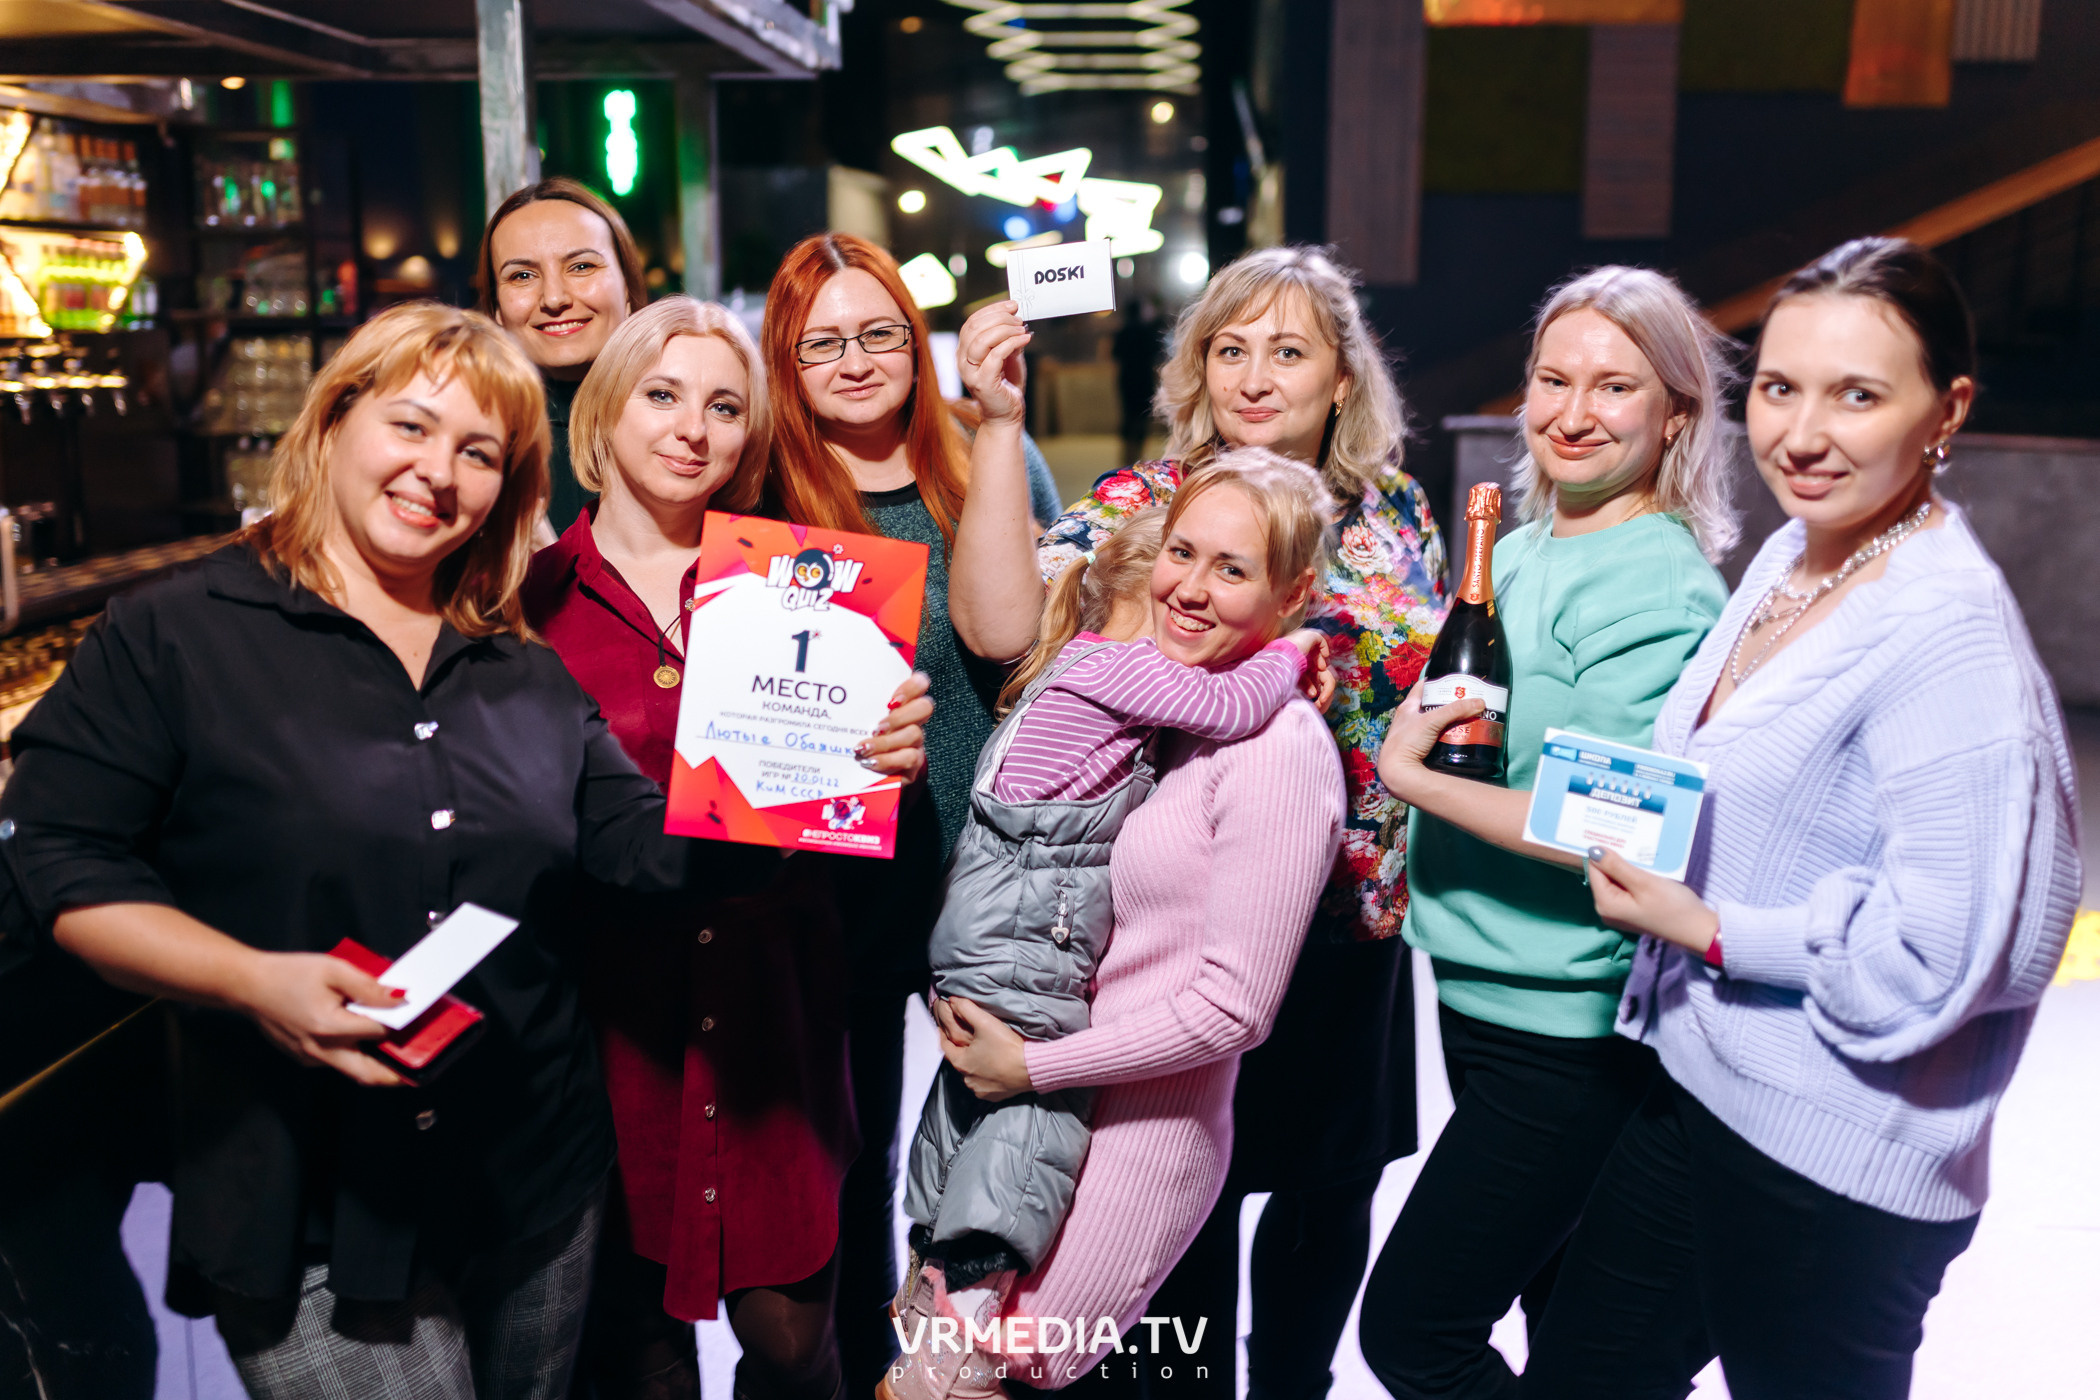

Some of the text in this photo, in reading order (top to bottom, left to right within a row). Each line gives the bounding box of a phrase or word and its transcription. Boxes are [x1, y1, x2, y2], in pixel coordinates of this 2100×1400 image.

[1034, 265, 1085, 285] DOSKI
[1472, 564, 1482, 588] SANTO
[781, 585, 834, 612] QUIZ
[751, 674, 847, 705] МЕСТО
[761, 701, 832, 719] КОМАНДА,
[705, 720, 772, 746] Лютые
[758, 759, 821, 774] ПОБЕДИТЕЛИ
[1579, 751, 1612, 765] ШКОЛА
[1589, 787, 1642, 808] ДЕПОЗИТ
